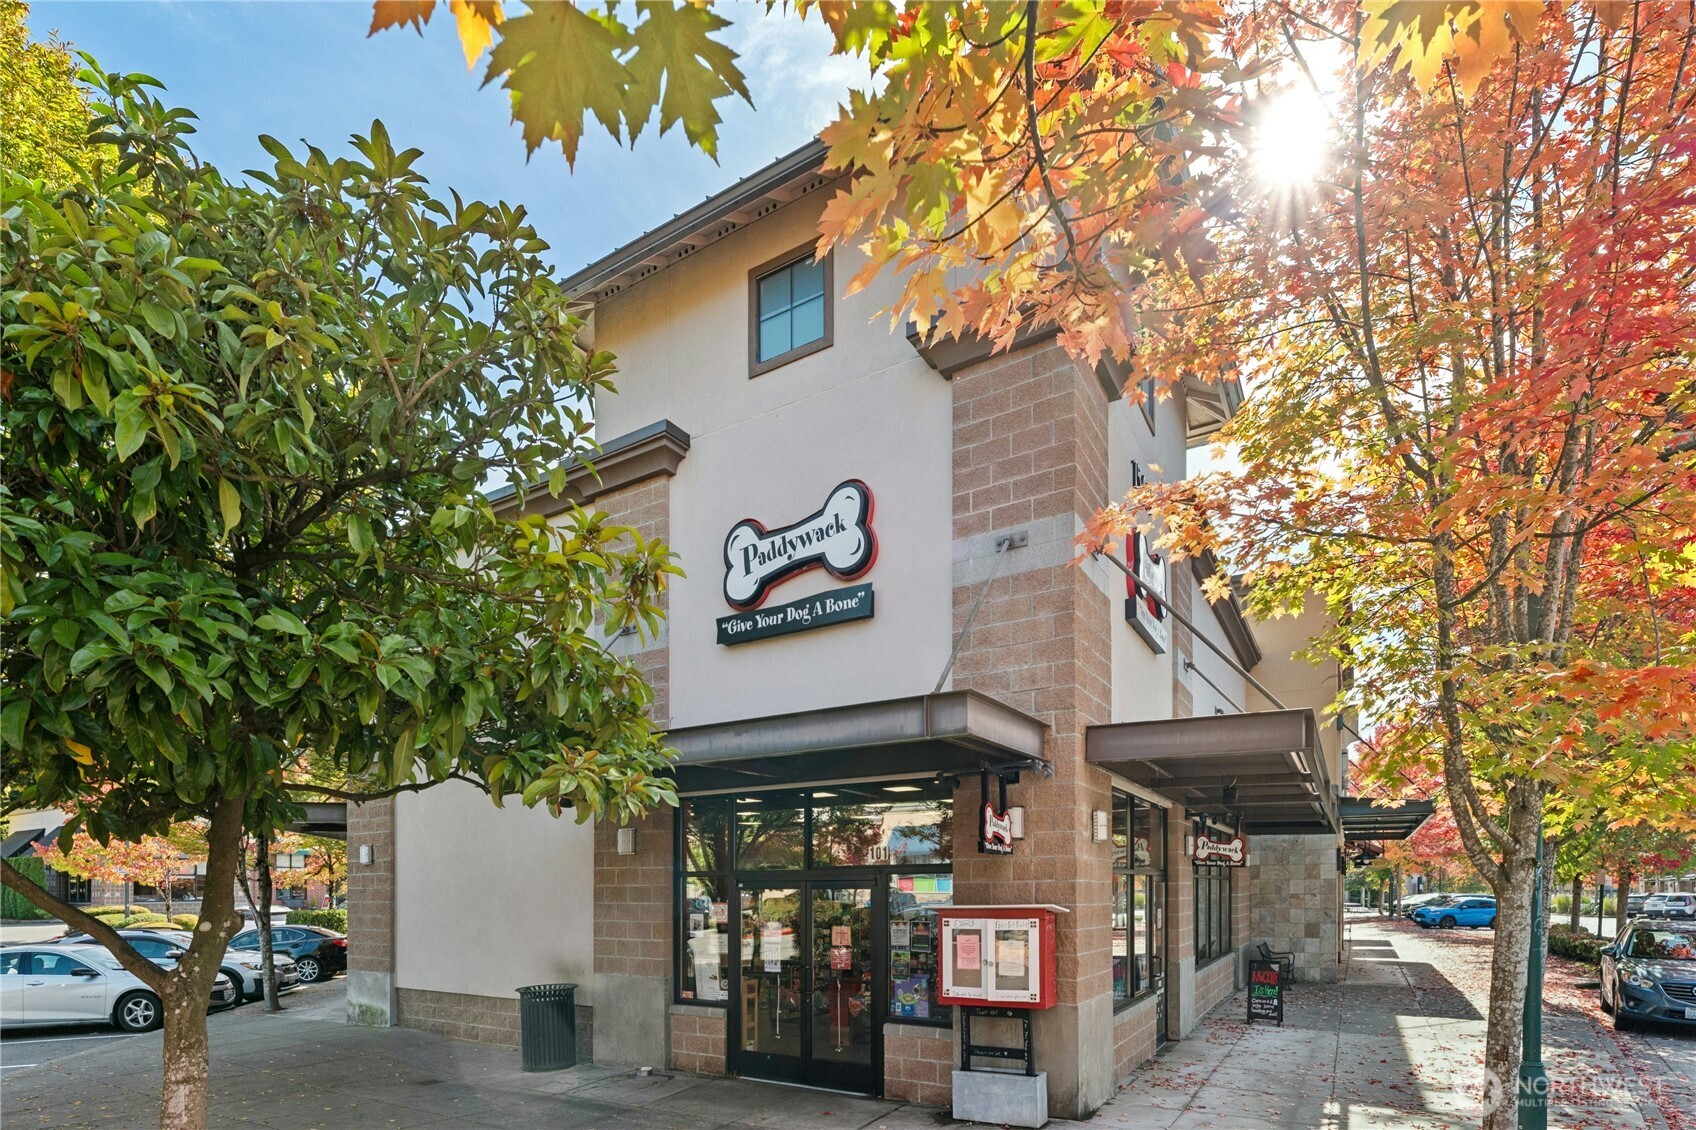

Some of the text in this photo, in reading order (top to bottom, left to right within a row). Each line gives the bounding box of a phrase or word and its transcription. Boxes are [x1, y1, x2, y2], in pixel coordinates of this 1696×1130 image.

[739, 512, 848, 577] Paddywack
[755, 612, 784, 629] Your
[786, 604, 812, 624] Dog
[812, 601, 824, 616] A
[870, 846, 887, 860] 101
[1201, 840, 1239, 853] Paddywack
